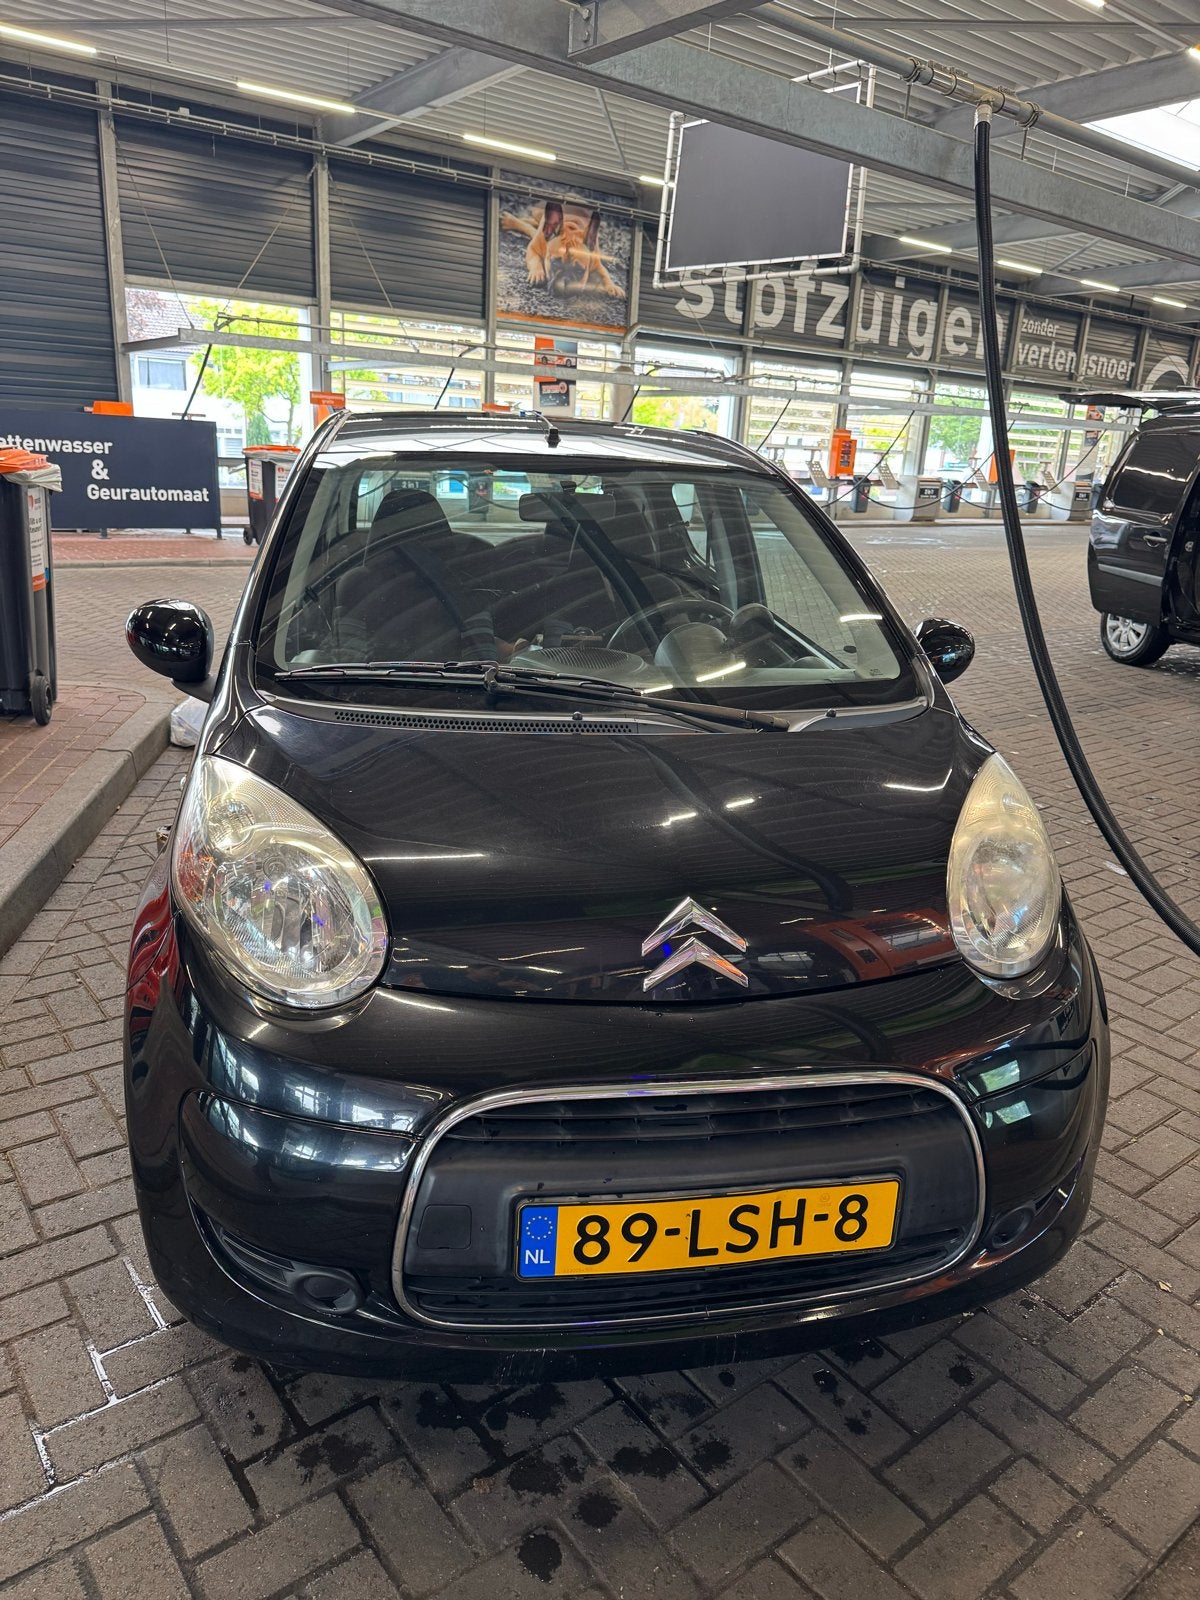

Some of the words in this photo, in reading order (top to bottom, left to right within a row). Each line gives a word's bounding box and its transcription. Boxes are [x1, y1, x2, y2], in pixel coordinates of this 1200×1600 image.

[1021, 317, 1060, 338] zonder
[91, 459, 110, 481] &
[87, 483, 210, 502] Geurautomaat
[572, 1193, 869, 1266] 89-LSH-8
[525, 1249, 551, 1265] NL
